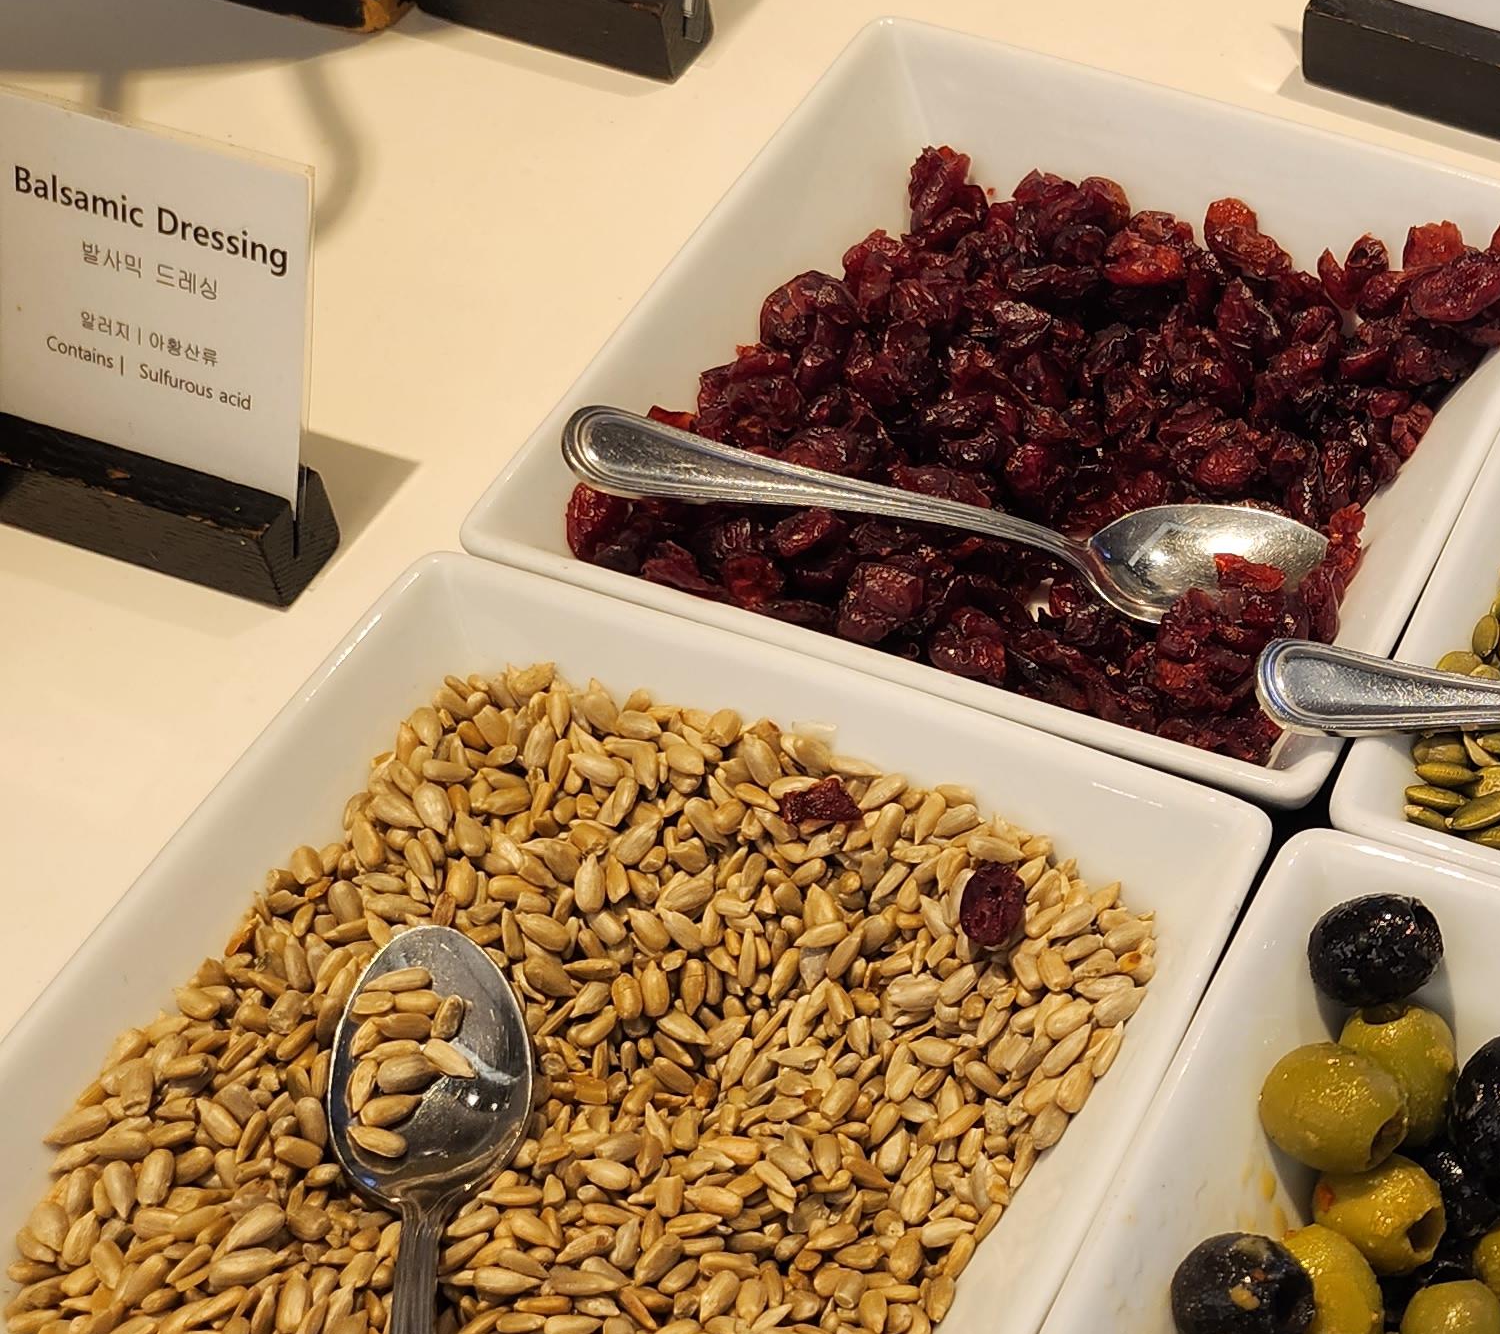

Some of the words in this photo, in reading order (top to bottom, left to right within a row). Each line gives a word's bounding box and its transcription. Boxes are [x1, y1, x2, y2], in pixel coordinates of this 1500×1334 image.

[14, 164, 144, 228] Balsamic
[157, 205, 288, 278] Dressing
[82, 240, 142, 279] 발사믹
[155, 263, 217, 301] 드레싱
[46, 335, 114, 369] Contains
[139, 363, 213, 400] Sulfurous
[219, 391, 252, 411] acid
[80, 310, 130, 342] 알러지
[148, 331, 219, 368] 아황산류
